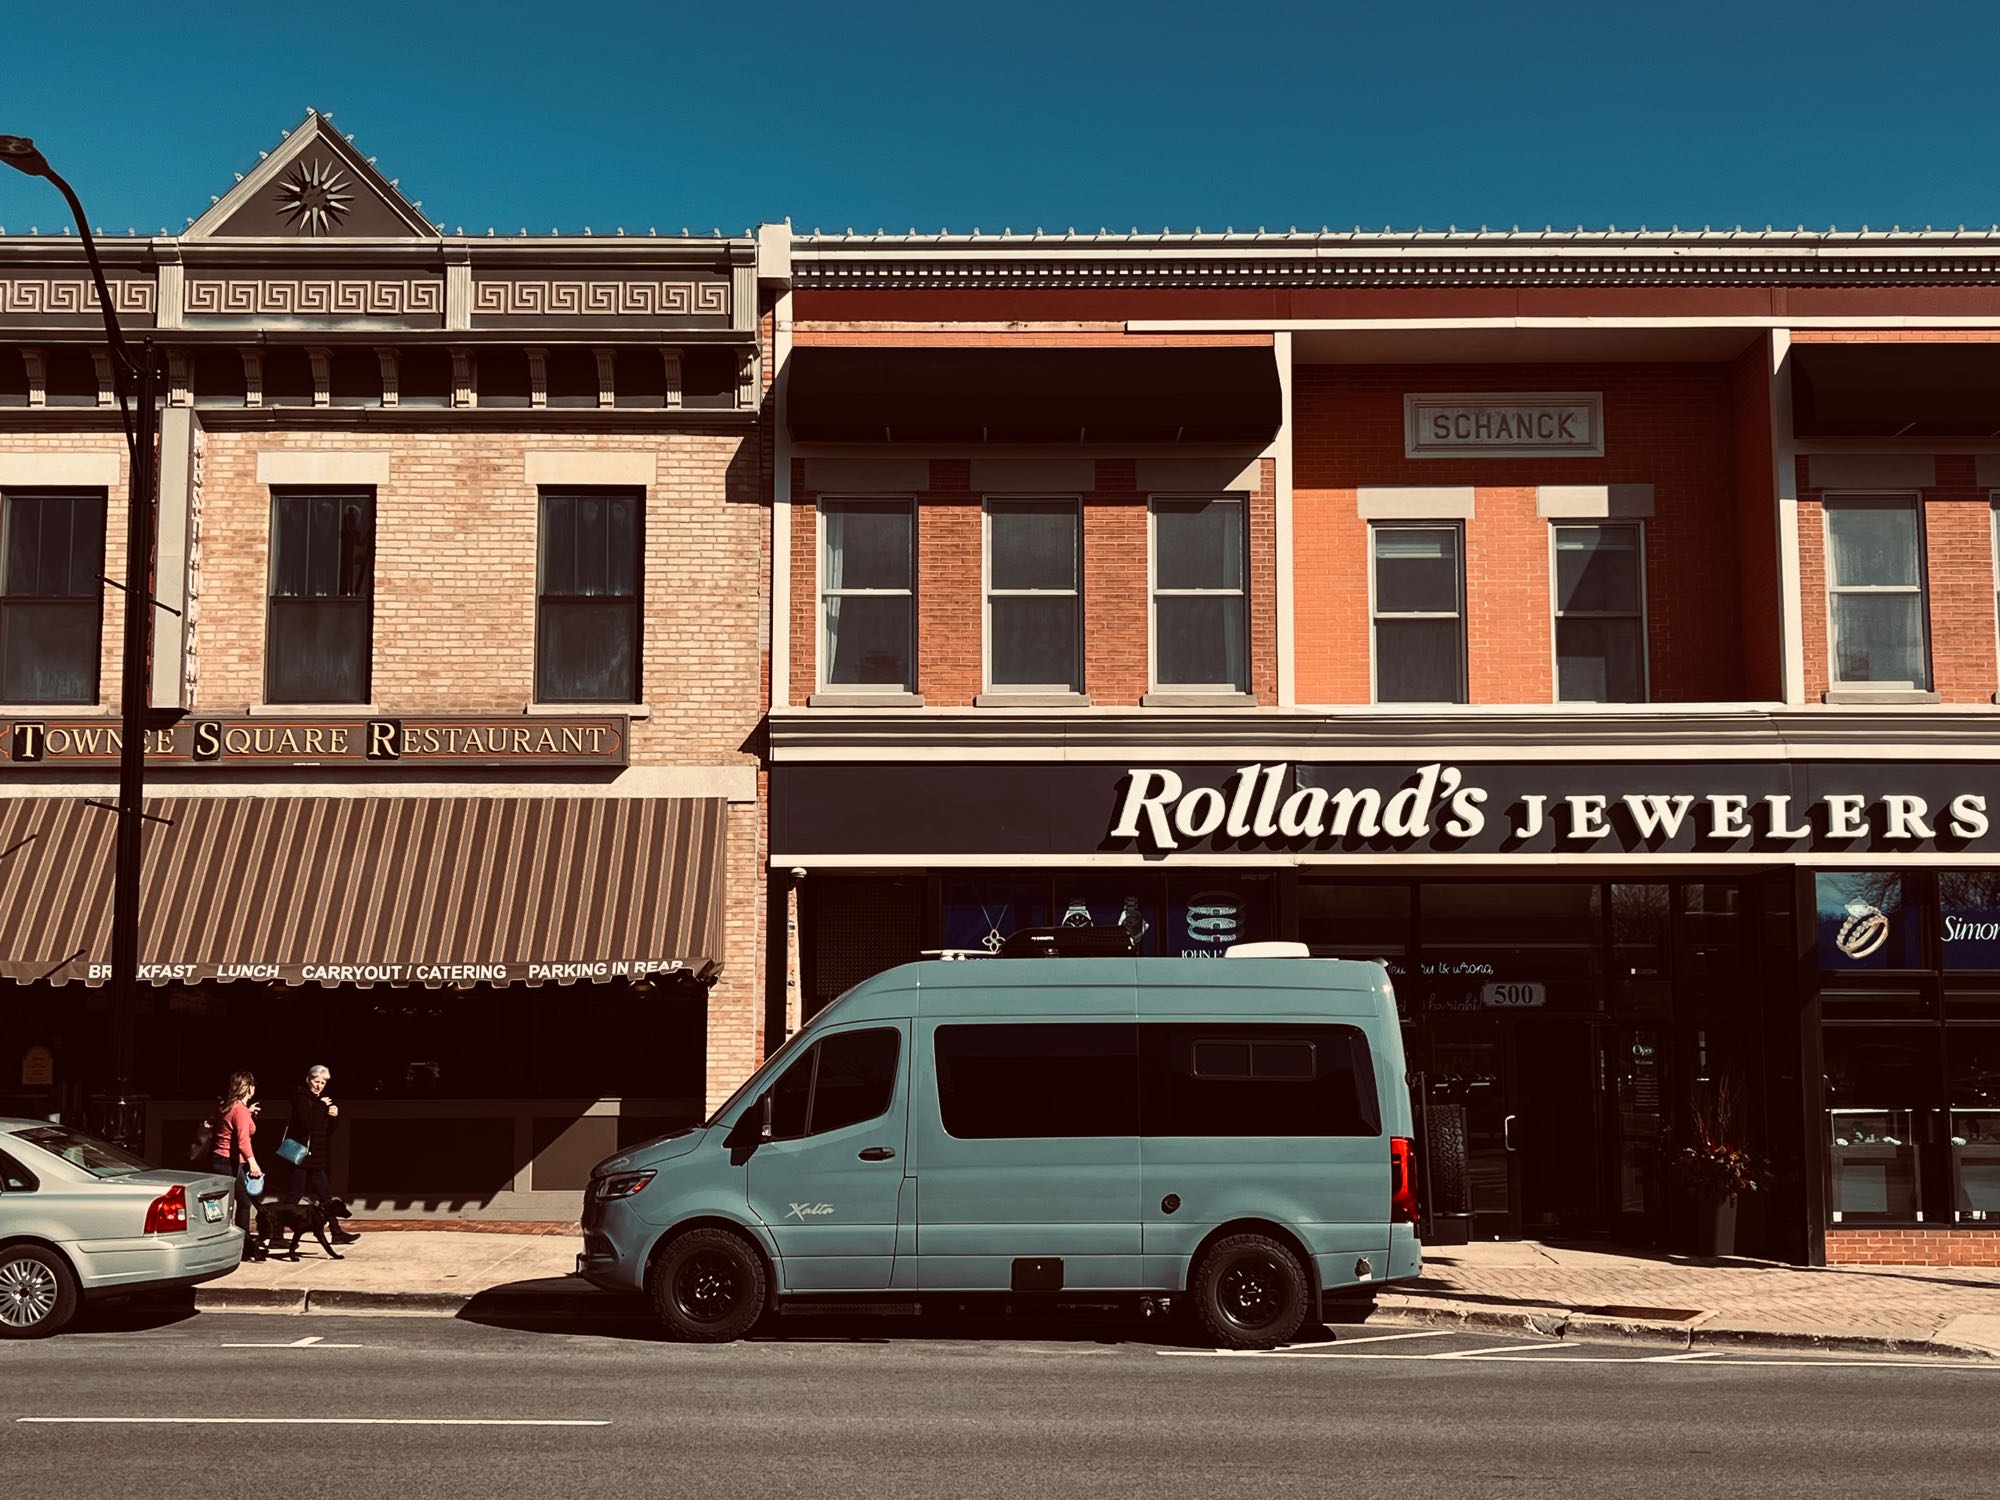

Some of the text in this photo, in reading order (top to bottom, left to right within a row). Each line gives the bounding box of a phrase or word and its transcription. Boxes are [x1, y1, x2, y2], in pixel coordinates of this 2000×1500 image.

[1433, 413, 1576, 441] SCHANCK
[196, 722, 348, 756] SQUARE
[369, 722, 606, 757] RESTAURANT
[1110, 763, 1989, 848] Rolland's JEWELERS
[88, 964, 197, 979] BRKFAST
[217, 964, 280, 978] LUNCH
[301, 964, 401, 980] CARRYOUT
[406, 966, 412, 978] /
[416, 964, 507, 980] CATERING
[528, 962, 607, 979] PARKING
[612, 961, 629, 976] IN
[1494, 984, 1533, 1004] 500
